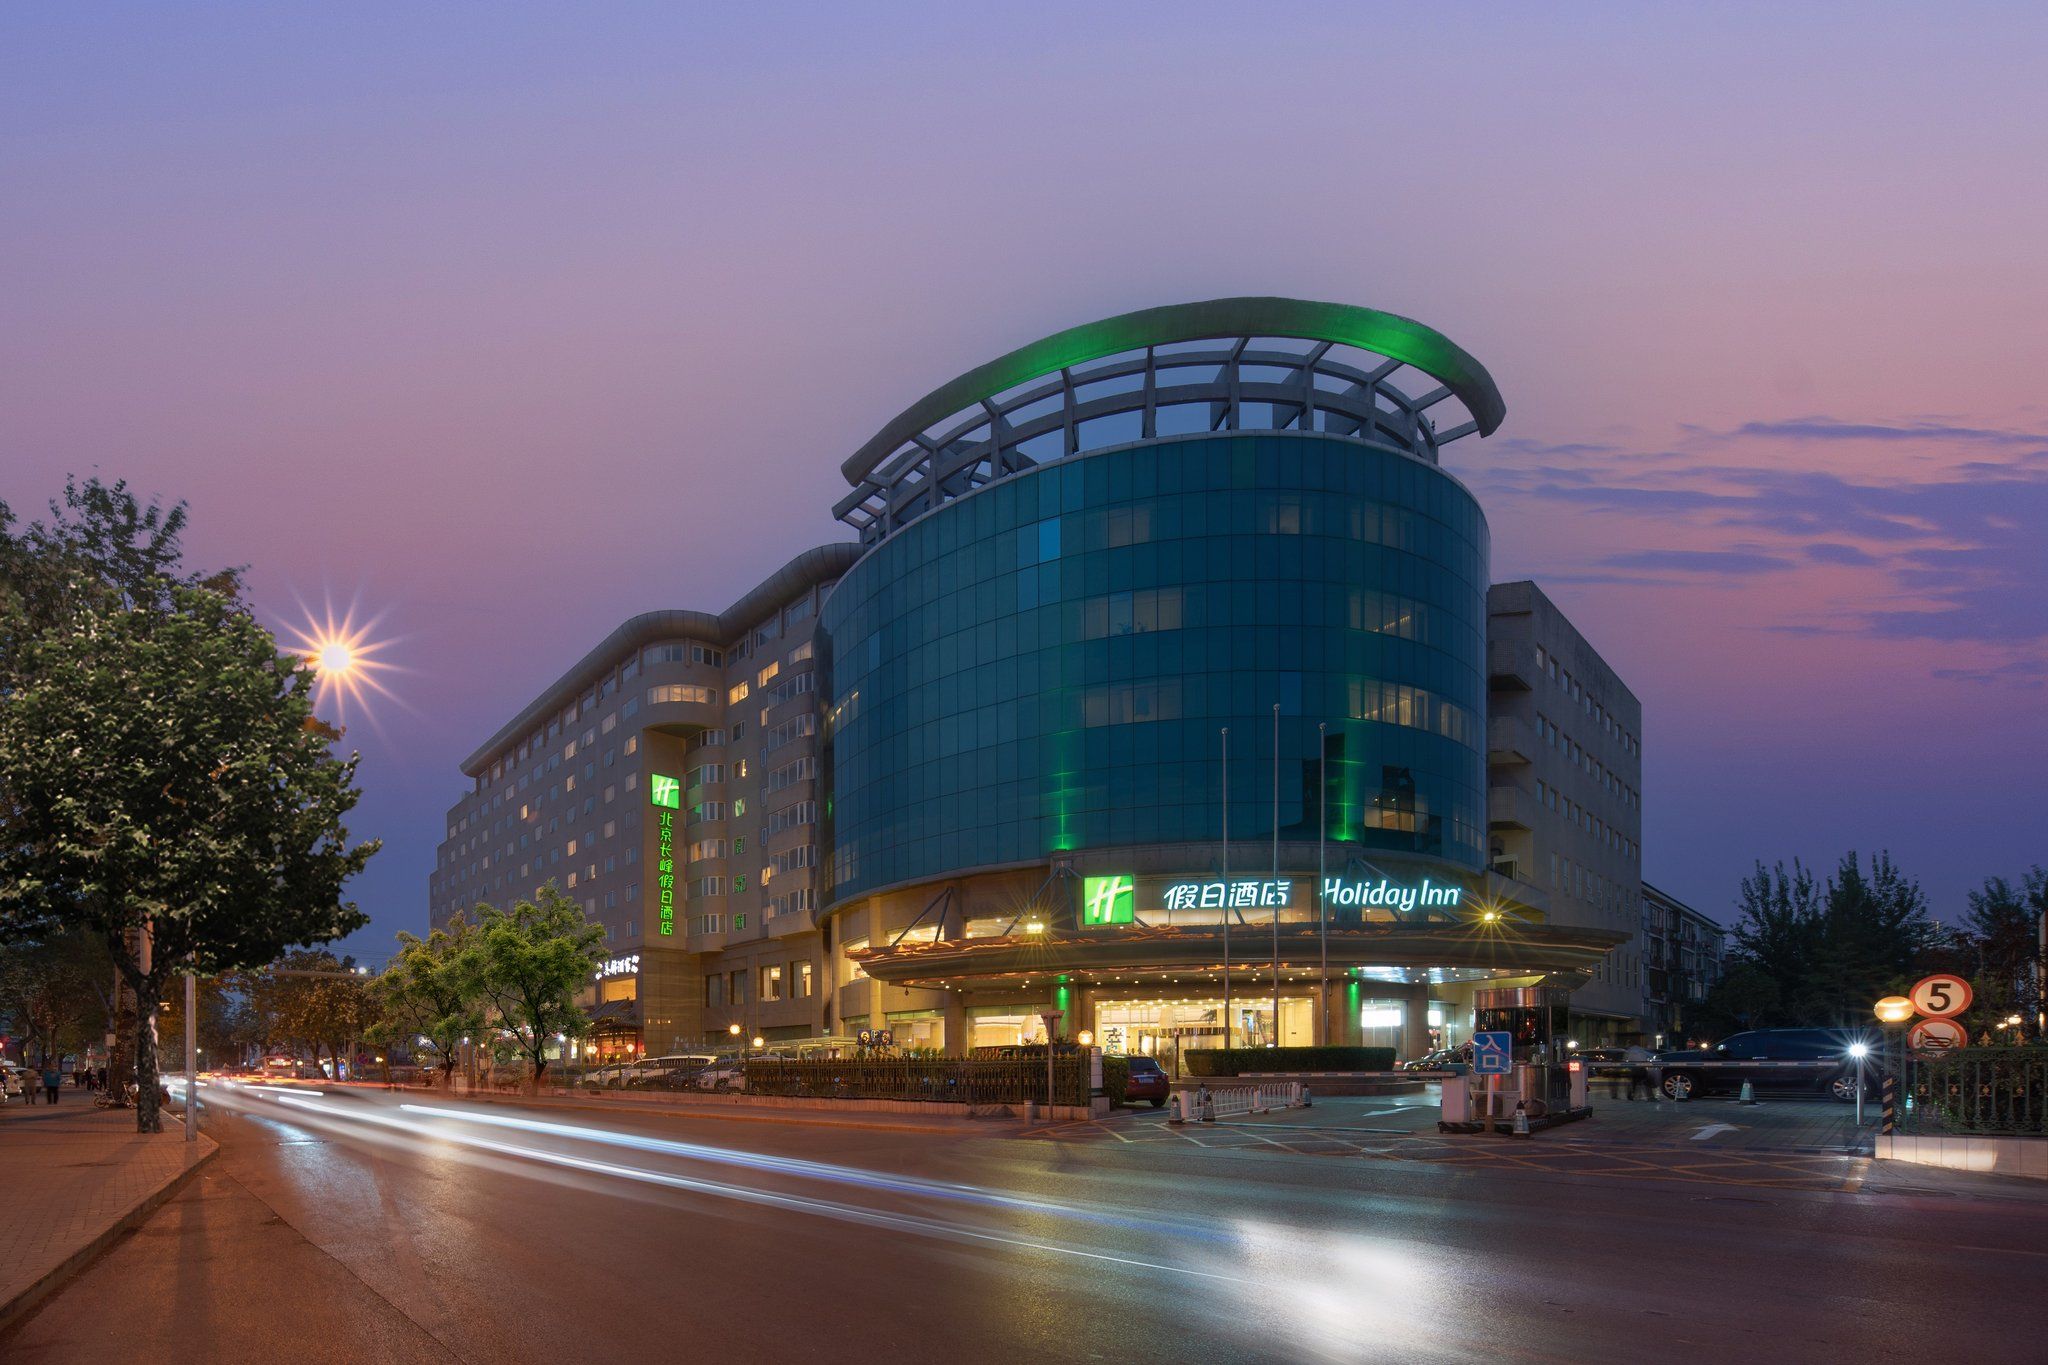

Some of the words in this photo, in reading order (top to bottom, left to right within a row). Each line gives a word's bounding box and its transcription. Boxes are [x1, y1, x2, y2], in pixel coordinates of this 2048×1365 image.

[658, 811, 674, 936] 北京长峰假日酒店
[1163, 880, 1291, 910] 假日酒店
[1320, 878, 1417, 912] Holiday
[1420, 879, 1460, 906] Inn
[1927, 983, 1952, 1012] 5
[1481, 1035, 1502, 1069] 入口
